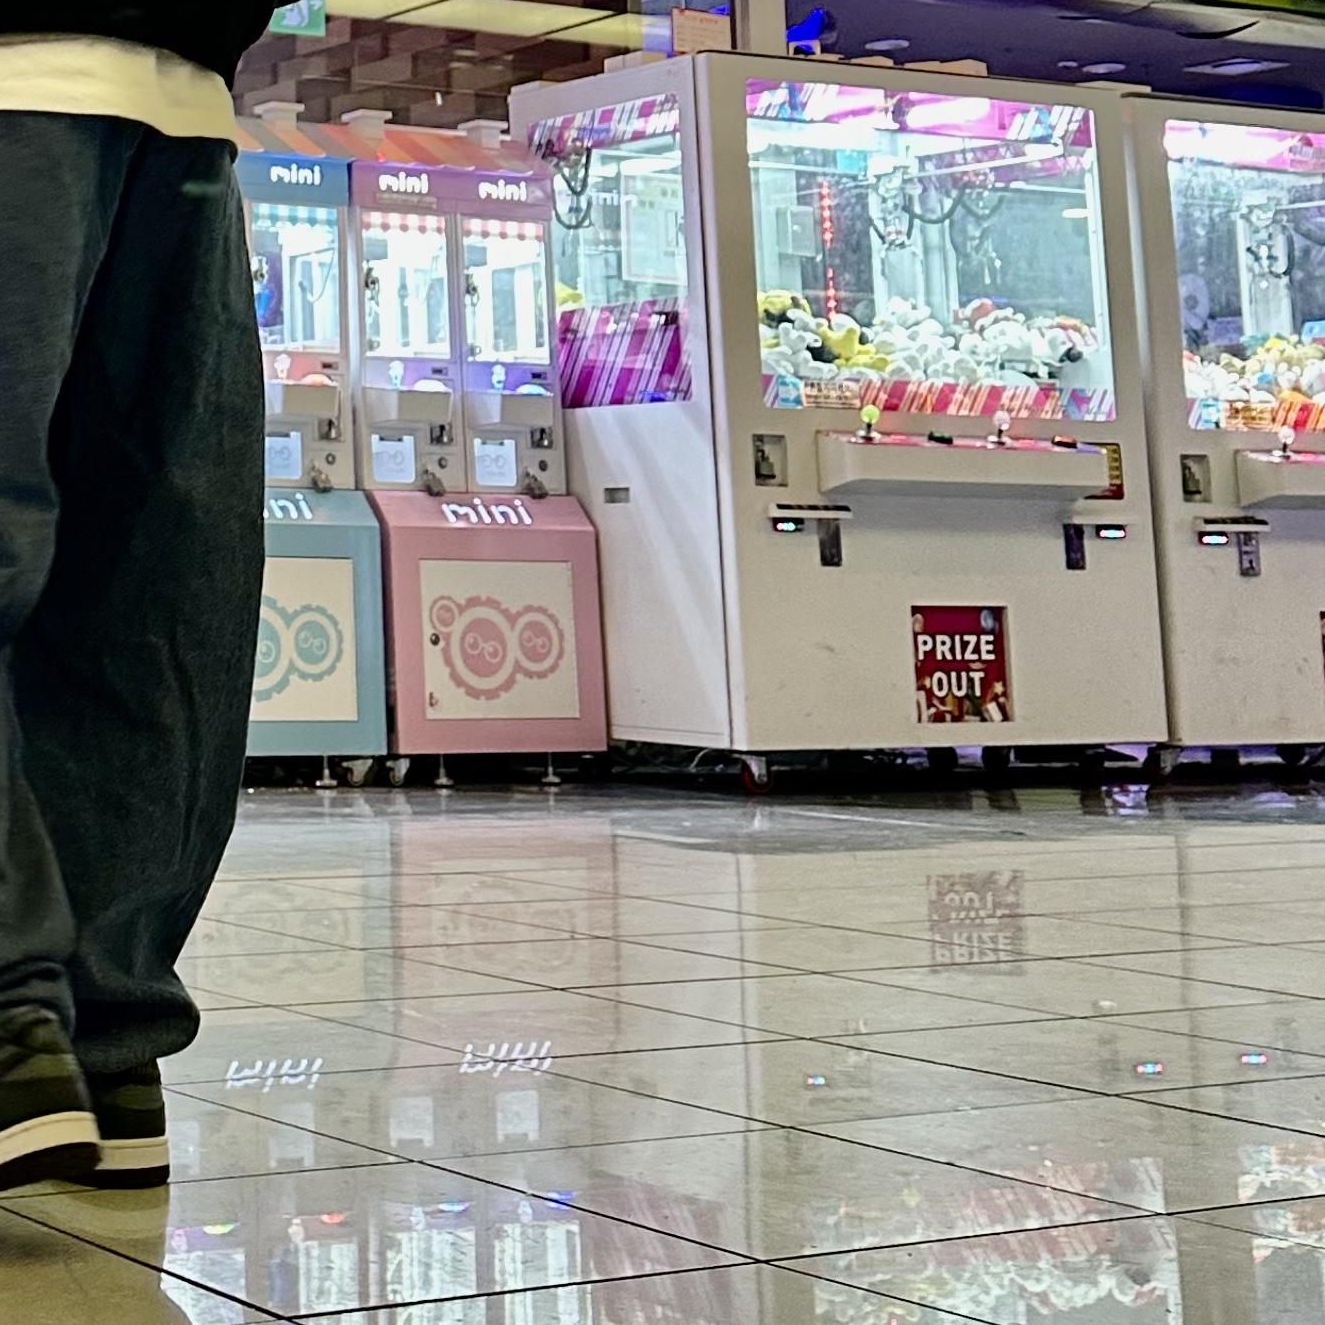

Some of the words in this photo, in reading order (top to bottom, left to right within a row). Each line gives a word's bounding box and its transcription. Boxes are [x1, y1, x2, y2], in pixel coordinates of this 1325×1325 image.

[270, 164, 322, 186] mini
[378, 171, 429, 195] mini
[478, 179, 527, 202] mini
[263, 492, 313, 521] ni
[442, 498, 533, 525] mini
[916, 633, 996, 662] PRIZE
[931, 670, 985, 699] OUT
